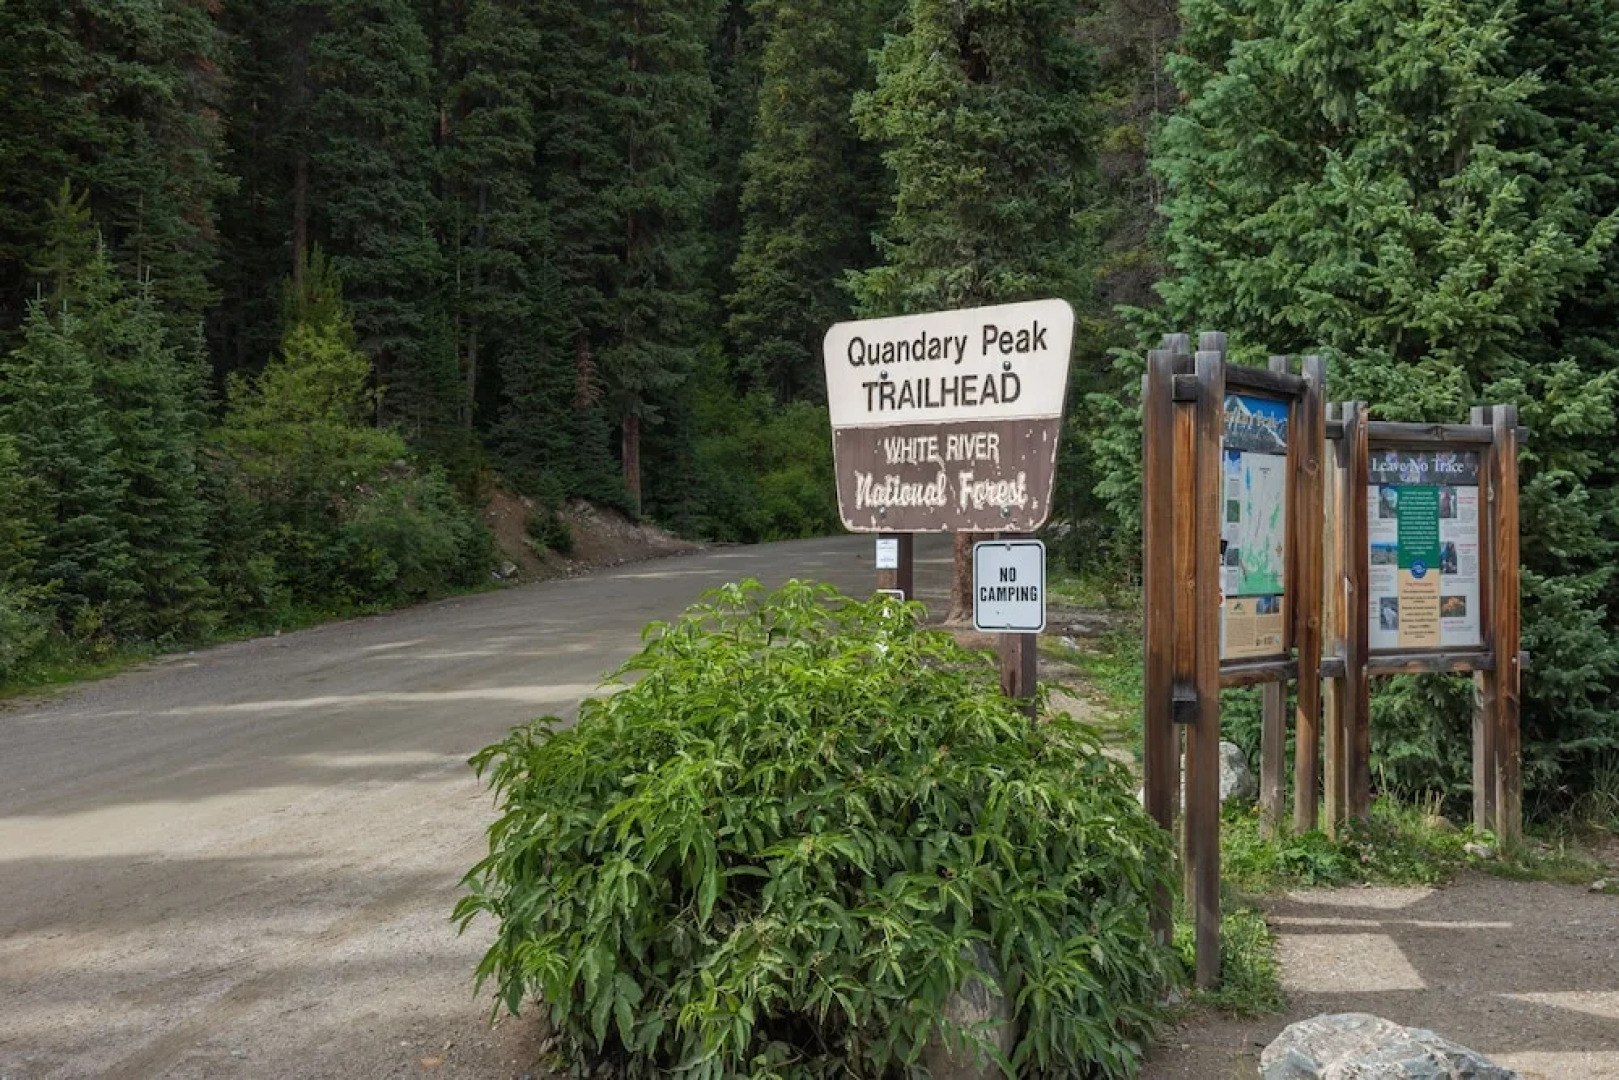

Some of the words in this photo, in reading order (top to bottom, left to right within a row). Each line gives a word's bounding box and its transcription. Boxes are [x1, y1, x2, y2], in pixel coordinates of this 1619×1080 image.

[848, 331, 968, 367] Quandary
[982, 320, 1047, 356] Peak
[862, 372, 1021, 411] TRAILHEAD
[884, 436, 938, 464] WHITE
[946, 432, 999, 461] RIVER
[1372, 458, 1409, 472] Leave
[1409, 458, 1428, 472] No
[1431, 457, 1464, 472] Trace
[855, 469, 946, 509] National
[959, 470, 1028, 510] Forest
[999, 567, 1016, 582] NO
[980, 586, 1037, 602] CAMPING
